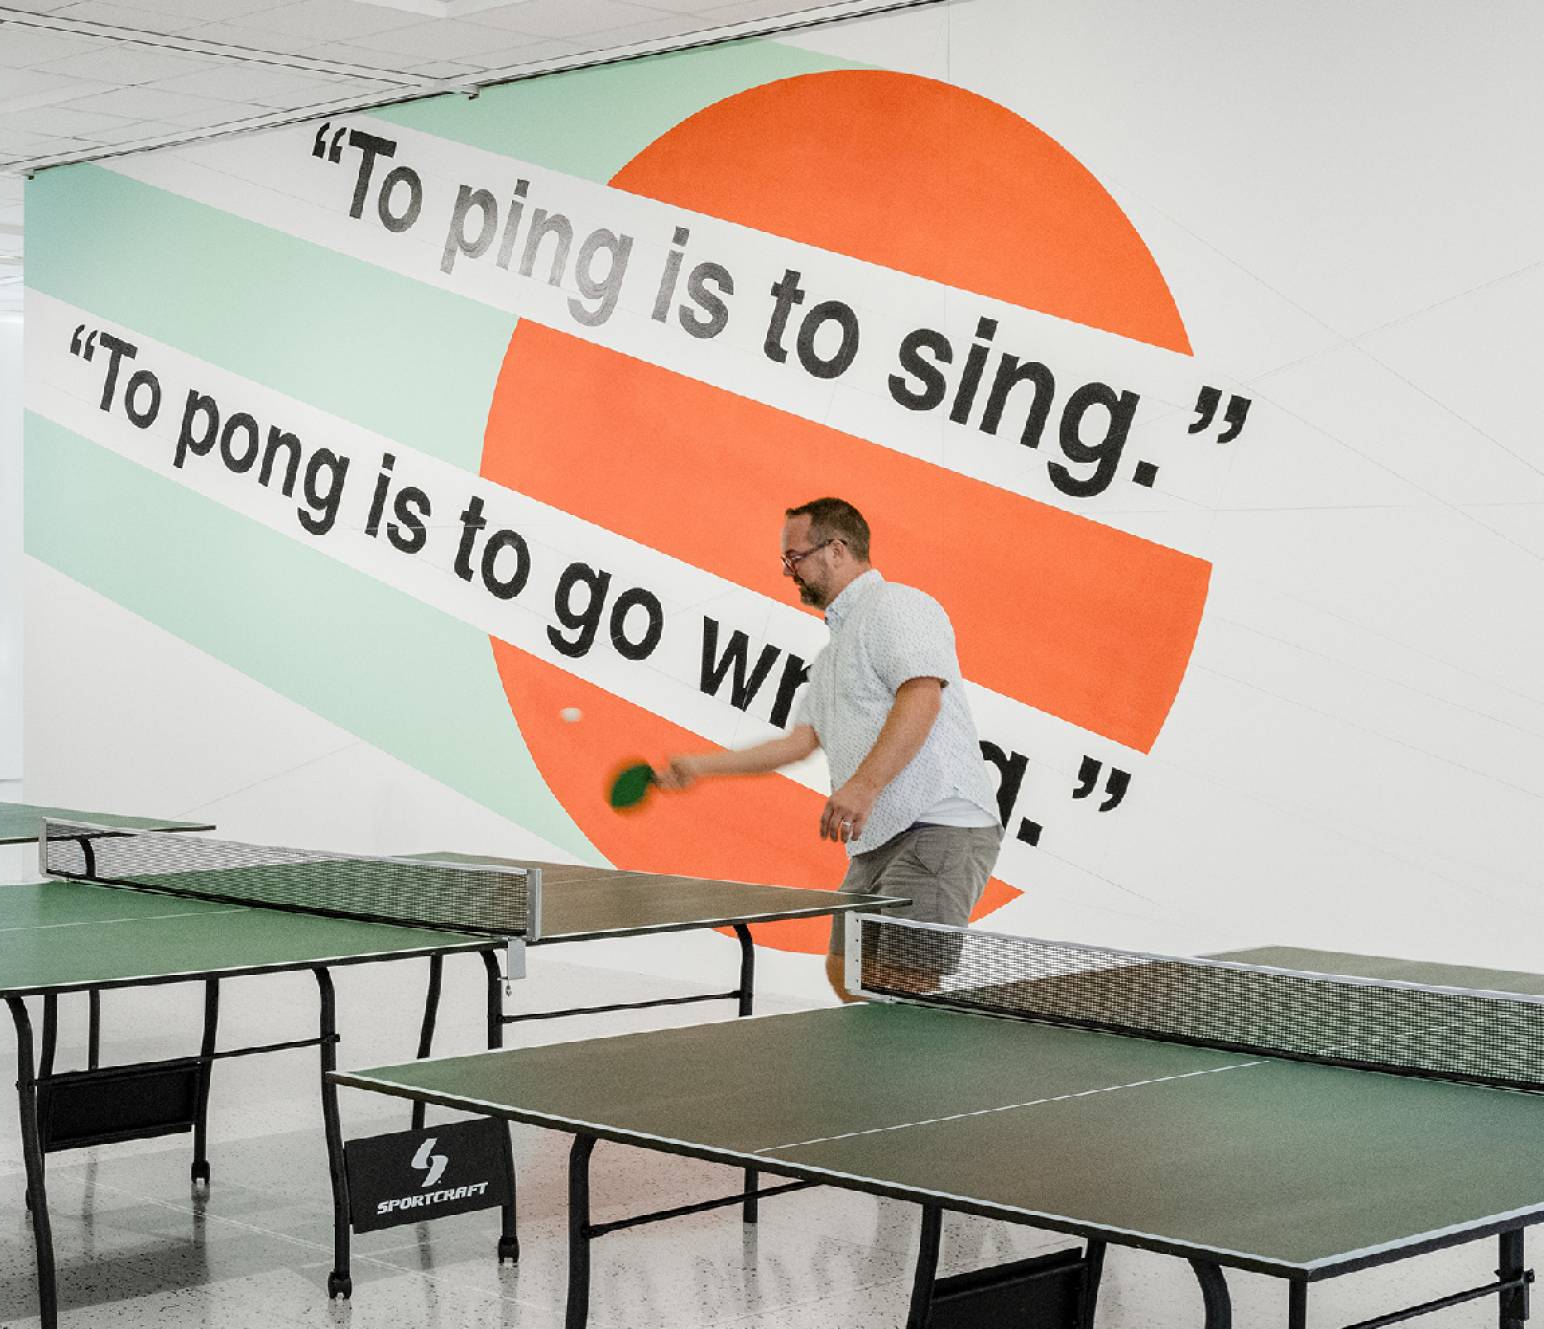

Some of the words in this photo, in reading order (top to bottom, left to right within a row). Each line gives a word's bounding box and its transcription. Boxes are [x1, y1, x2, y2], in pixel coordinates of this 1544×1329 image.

[311, 121, 423, 233] “To
[440, 178, 634, 327] ping
[651, 225, 735, 340] is
[763, 268, 860, 380] to
[69, 323, 162, 430] “To
[172, 388, 351, 536] pong
[363, 452, 432, 555] is
[453, 495, 532, 601] to
[546, 561, 665, 661] go
[377, 1181, 489, 1214] SPORTCRAFT
